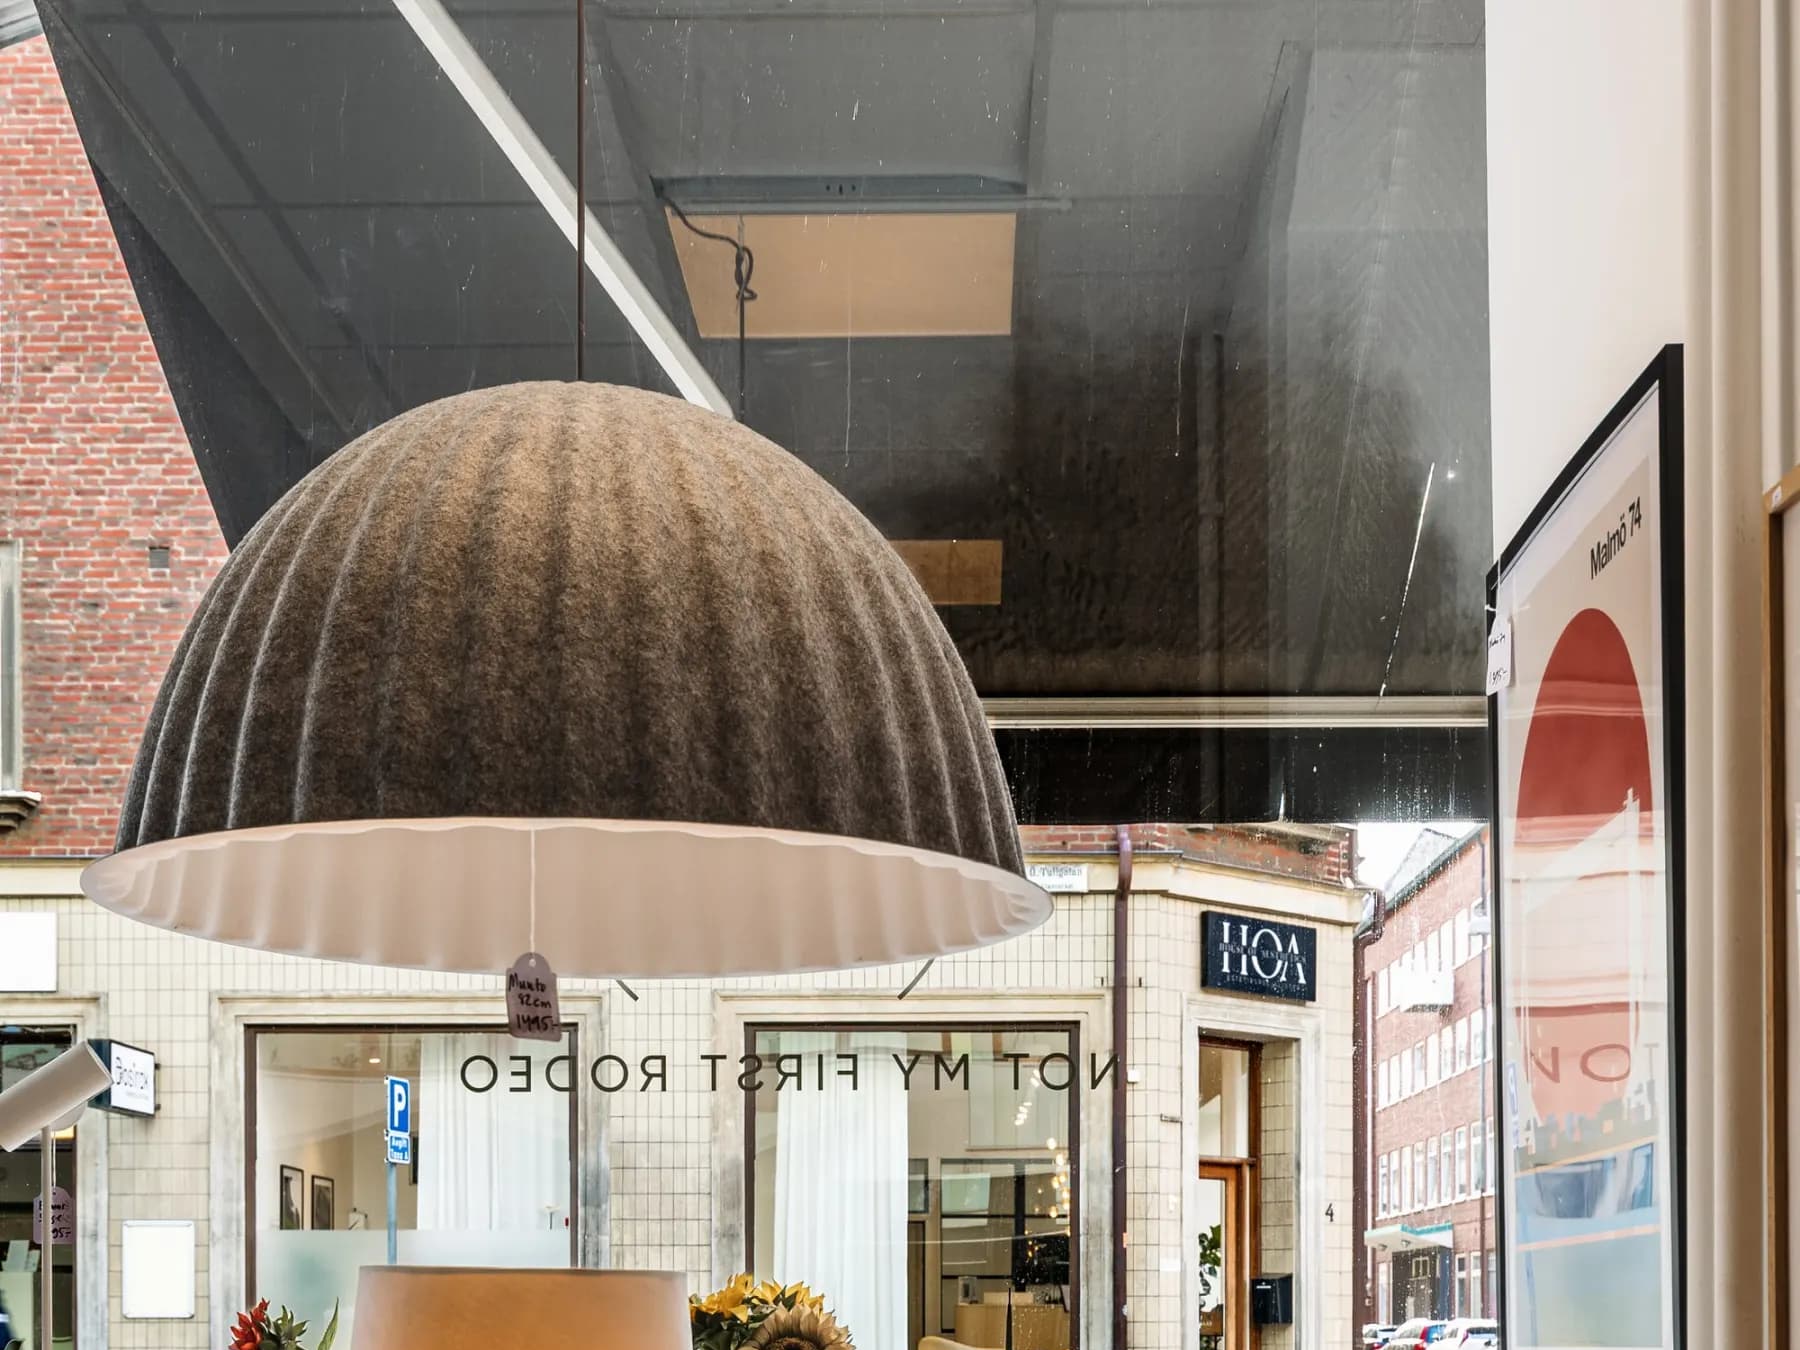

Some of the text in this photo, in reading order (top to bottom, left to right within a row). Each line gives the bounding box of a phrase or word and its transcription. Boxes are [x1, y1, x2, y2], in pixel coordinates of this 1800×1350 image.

[1590, 496, 1642, 580] Malmö 74
[1221, 921, 1307, 985] HOA
[394, 1084, 406, 1127] P
[1325, 1203, 1334, 1222] 4
